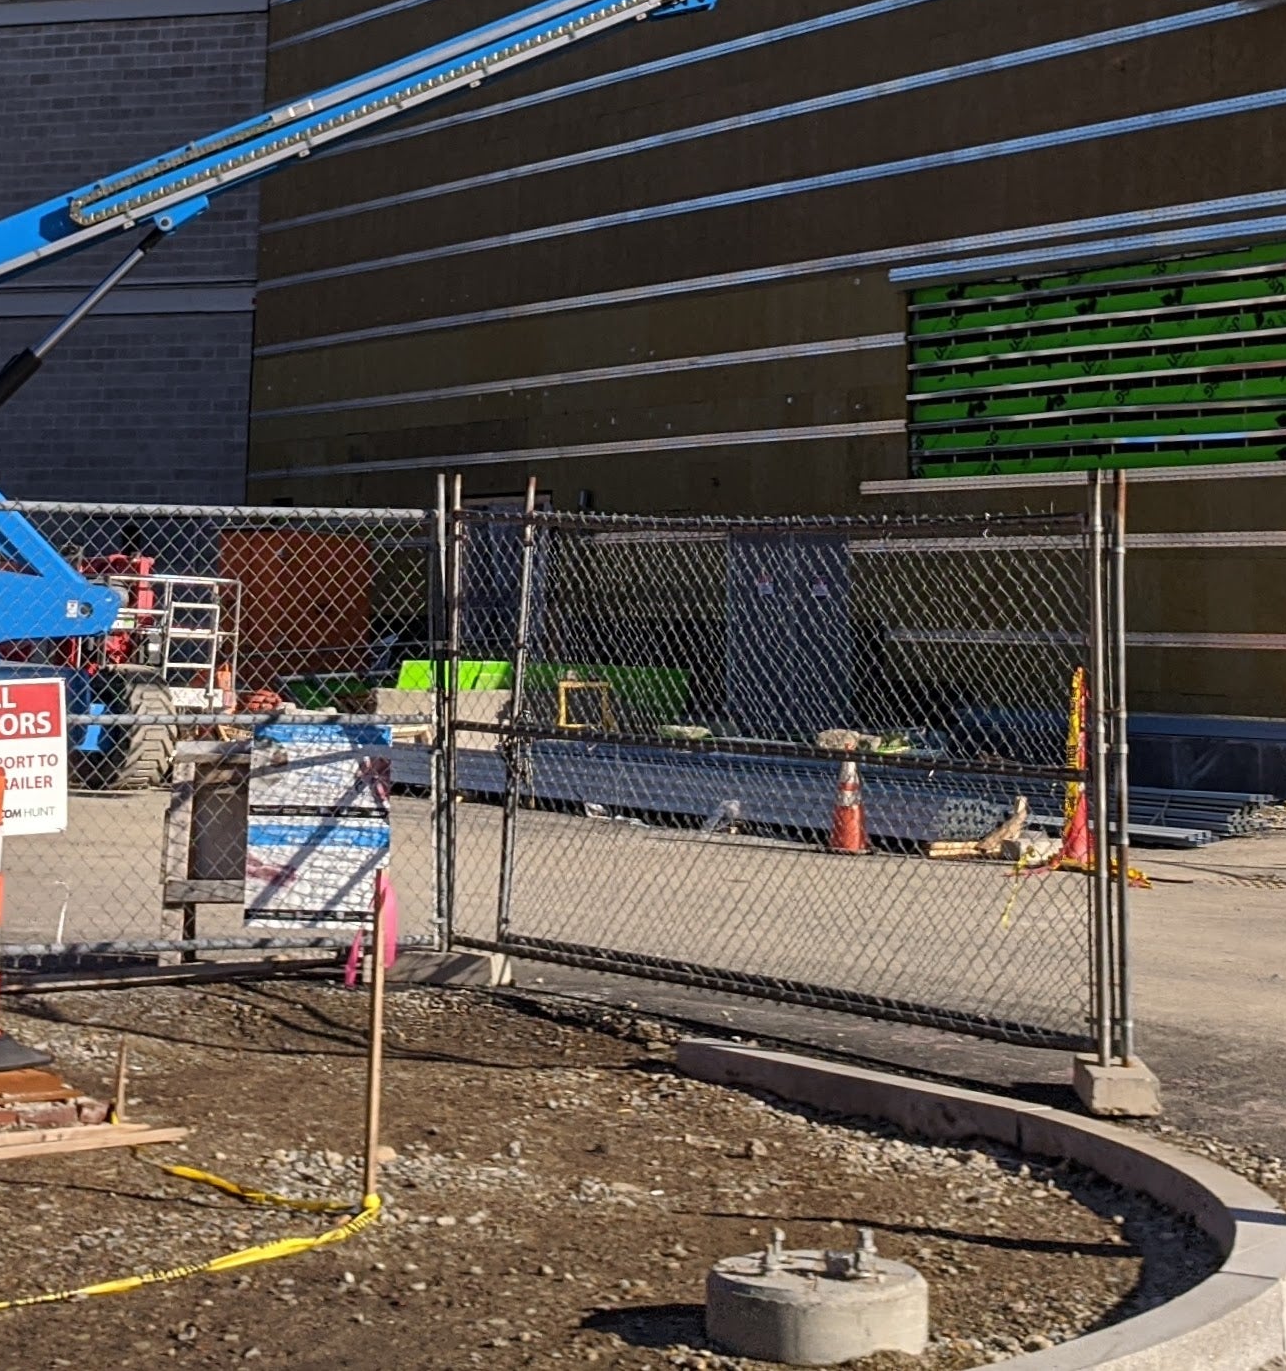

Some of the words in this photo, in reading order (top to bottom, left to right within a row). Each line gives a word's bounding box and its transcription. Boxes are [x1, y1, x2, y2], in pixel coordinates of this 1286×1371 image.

[38, 754, 58, 767] TO
[4, 776, 53, 790] RAILER
[24, 806, 55, 817] HUNT
